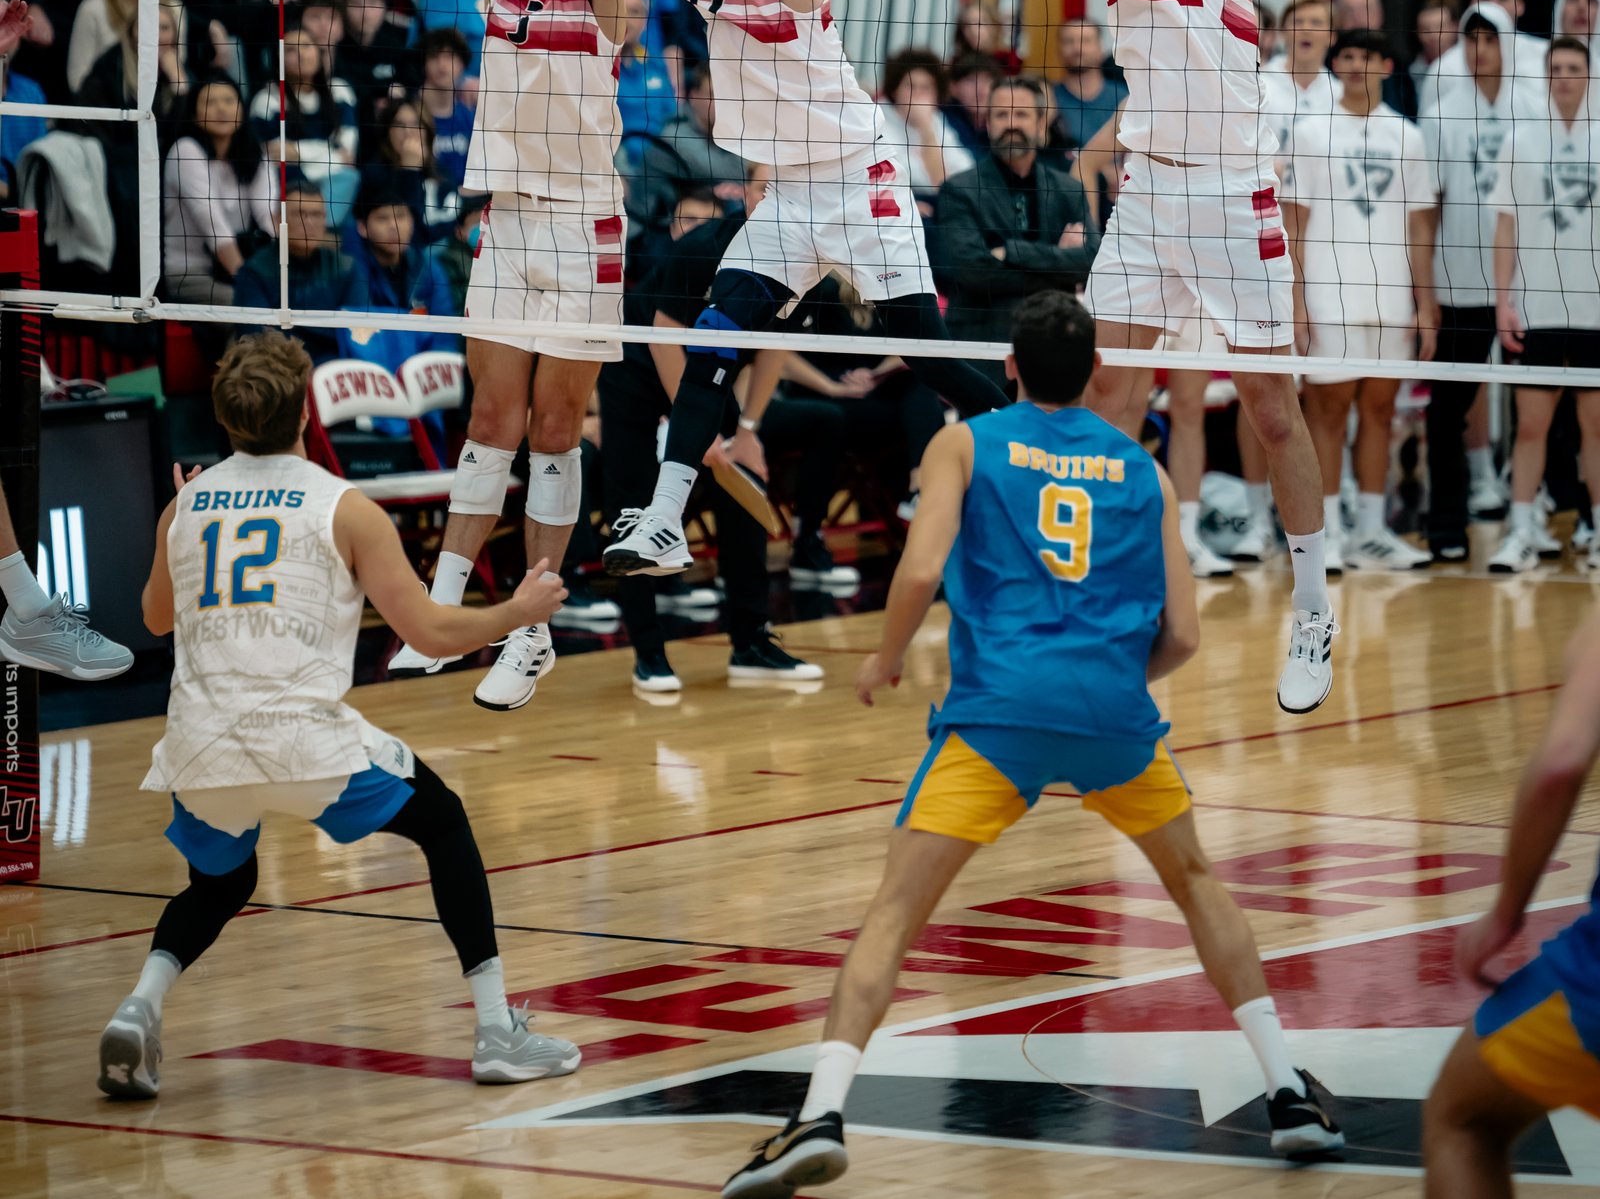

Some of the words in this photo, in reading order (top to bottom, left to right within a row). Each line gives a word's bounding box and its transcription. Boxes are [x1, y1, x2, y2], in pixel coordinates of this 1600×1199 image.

[324, 370, 395, 404] LEWIS
[1007, 441, 1126, 483] BRUINS
[191, 489, 306, 512] BRUINS
[1037, 481, 1093, 583] 9
[198, 515, 284, 612] 12
[4, 686, 20, 773] imports
